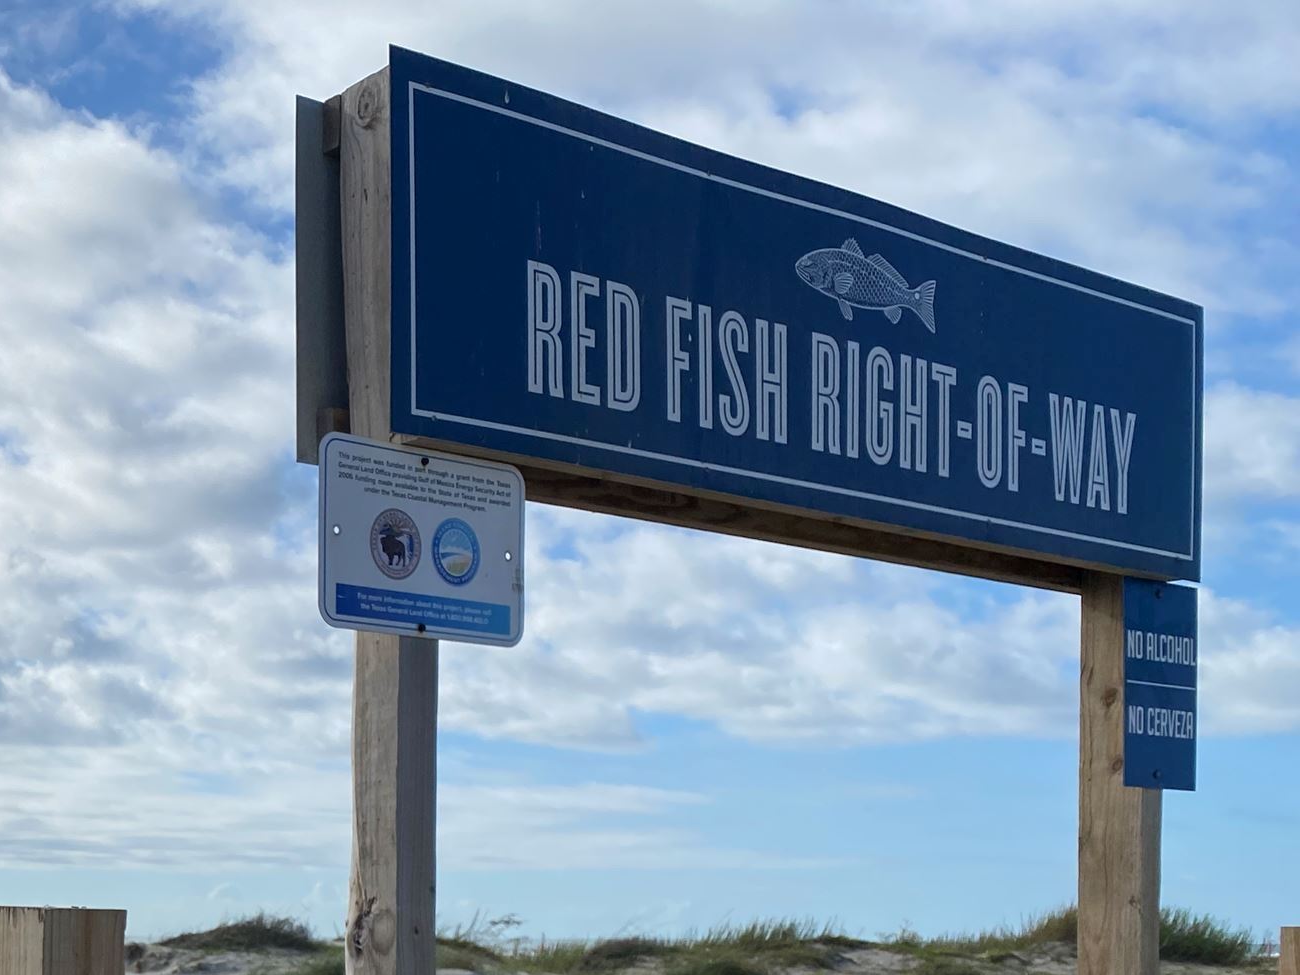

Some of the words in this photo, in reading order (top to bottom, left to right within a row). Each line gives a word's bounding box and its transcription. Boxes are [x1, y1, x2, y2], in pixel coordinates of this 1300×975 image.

[526, 260, 641, 413] RED
[666, 297, 789, 445] FISH
[811, 331, 1137, 515] RIGHT-OF-WAY
[338, 461, 360, 471] General
[361, 466, 374, 474] Land
[375, 468, 391, 477] Office
[392, 472, 417, 483] providing
[418, 475, 429, 483] Gulf
[436, 479, 455, 488] Mexico
[456, 482, 474, 492] Energy
[475, 486, 495, 496] Security
[352, 455, 371, 464] project
[386, 460, 406, 470] funded
[428, 469, 449, 478] through
[496, 480, 511, 489] Texas
[355, 474, 376, 485] funding
[378, 479, 393, 487] made
[395, 482, 419, 491] available
[438, 489, 452, 497] State
[461, 492, 476, 501] Texas
[391, 490, 407, 499] Texas
[407, 493, 428, 502] Coastal
[428, 496, 463, 508] Management
[1127, 629, 1142, 660] NO
[1146, 632, 1196, 666] ALCOHOL
[1128, 705, 1143, 735] NO
[1147, 707, 1194, 739] CERVEZA
